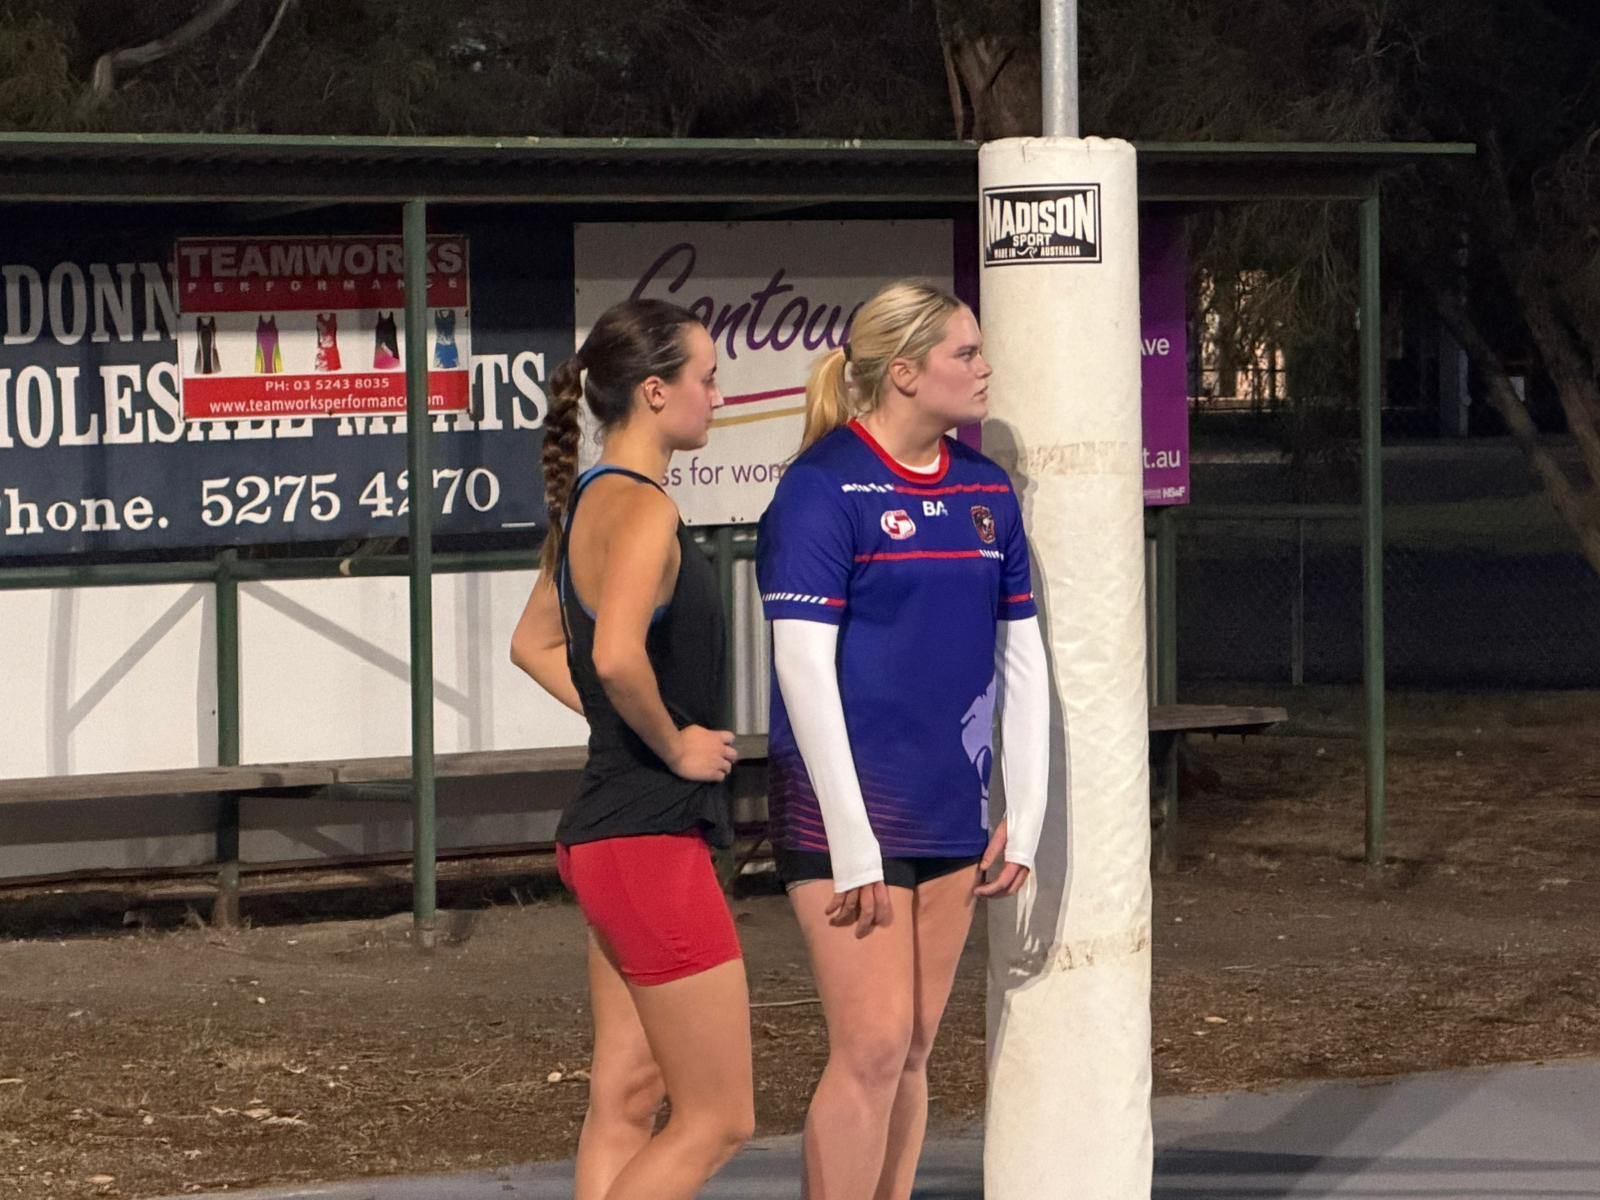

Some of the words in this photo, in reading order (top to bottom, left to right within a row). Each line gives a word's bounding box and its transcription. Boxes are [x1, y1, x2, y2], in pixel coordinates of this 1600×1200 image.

[985, 190, 1095, 253] MADISON
[1012, 233, 1052, 247] SPORT
[1040, 245, 1081, 257] AUSTRALIA
[265, 380, 290, 392] PH:
[293, 380, 311, 391] 03
[316, 379, 350, 390] 5243
[355, 377, 390, 389] 8035
[690, 456, 724, 486] for
[0, 488, 169, 536] hone.
[201, 473, 341, 527] 5275
